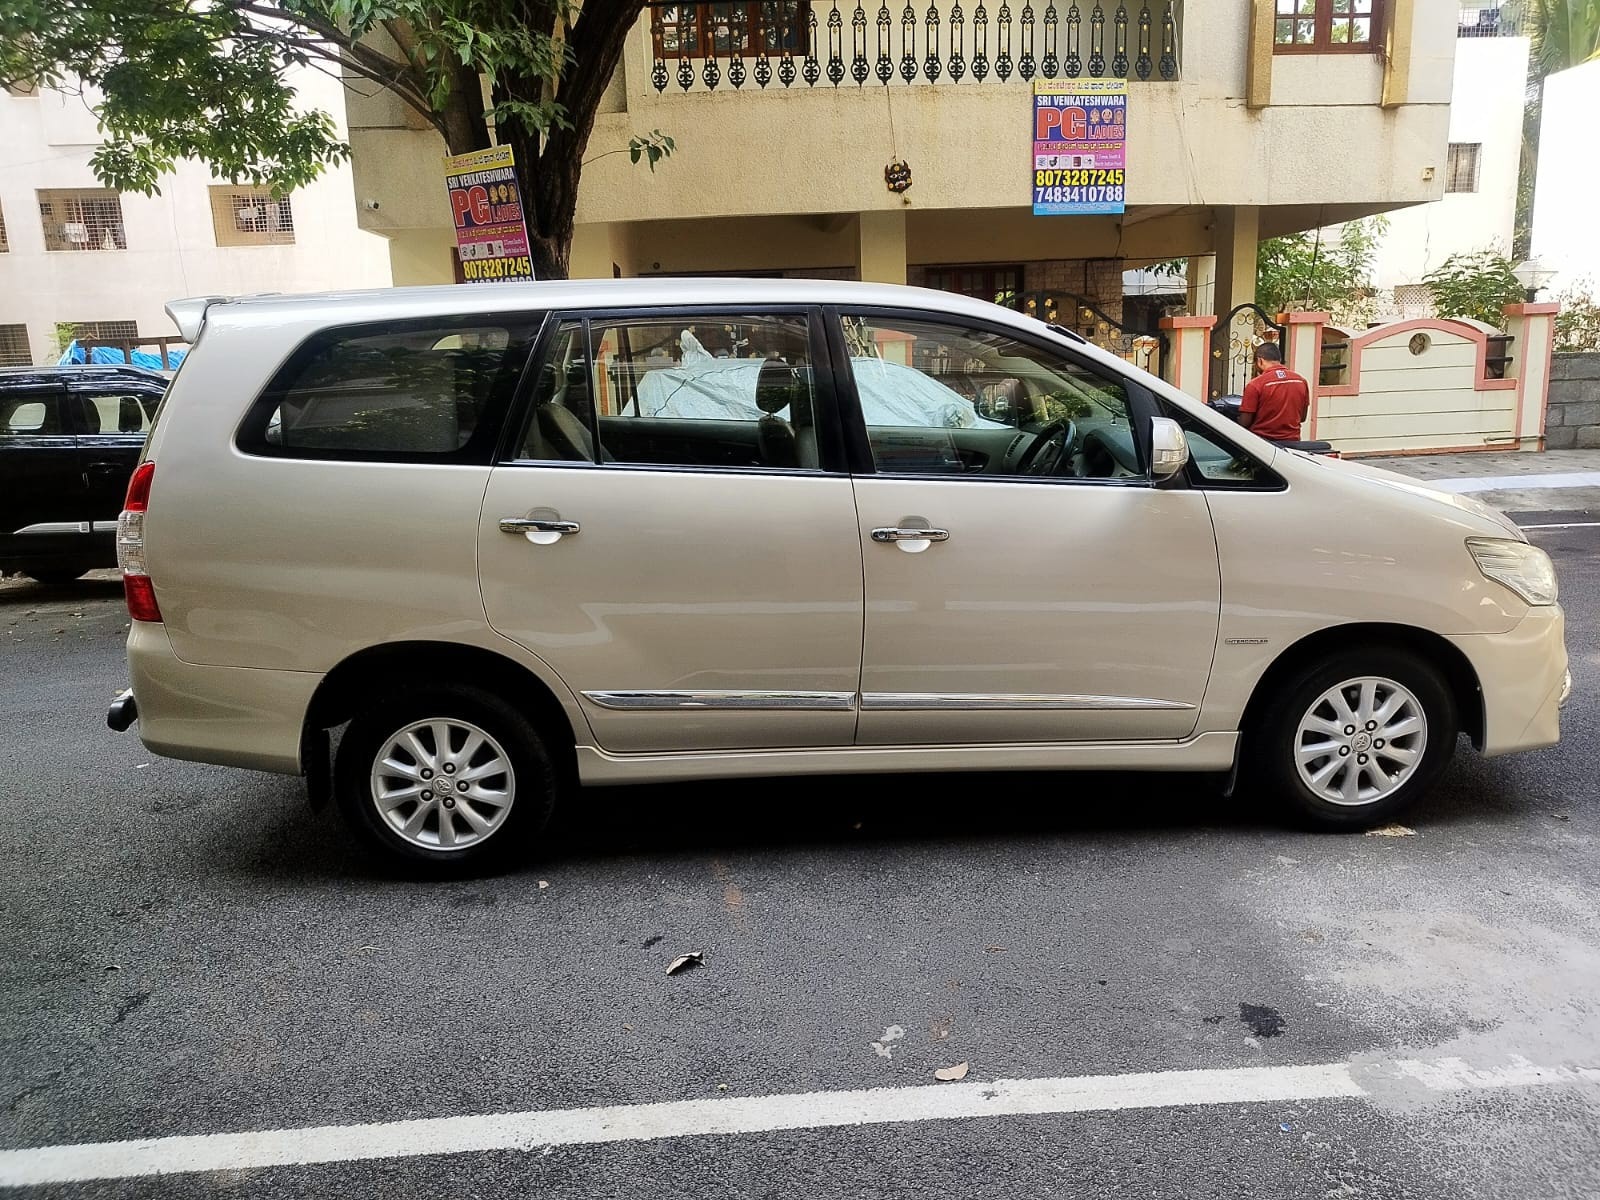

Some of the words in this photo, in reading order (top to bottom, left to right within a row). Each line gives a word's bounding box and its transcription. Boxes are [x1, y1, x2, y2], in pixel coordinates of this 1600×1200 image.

[1037, 95, 1051, 106] SRI
[1054, 95, 1125, 106] VENKATESHWARA
[1036, 106, 1087, 140] PG
[1088, 125, 1125, 139] LADIES
[448, 176, 459, 189] SRI
[460, 167, 515, 187] VENKATESHWARA
[1036, 169, 1124, 187] 8073287245
[1035, 186, 1123, 203] 7483410788
[450, 185, 493, 227] PG
[491, 202, 522, 223] LADIES
[463, 256, 531, 279] 8073287245
